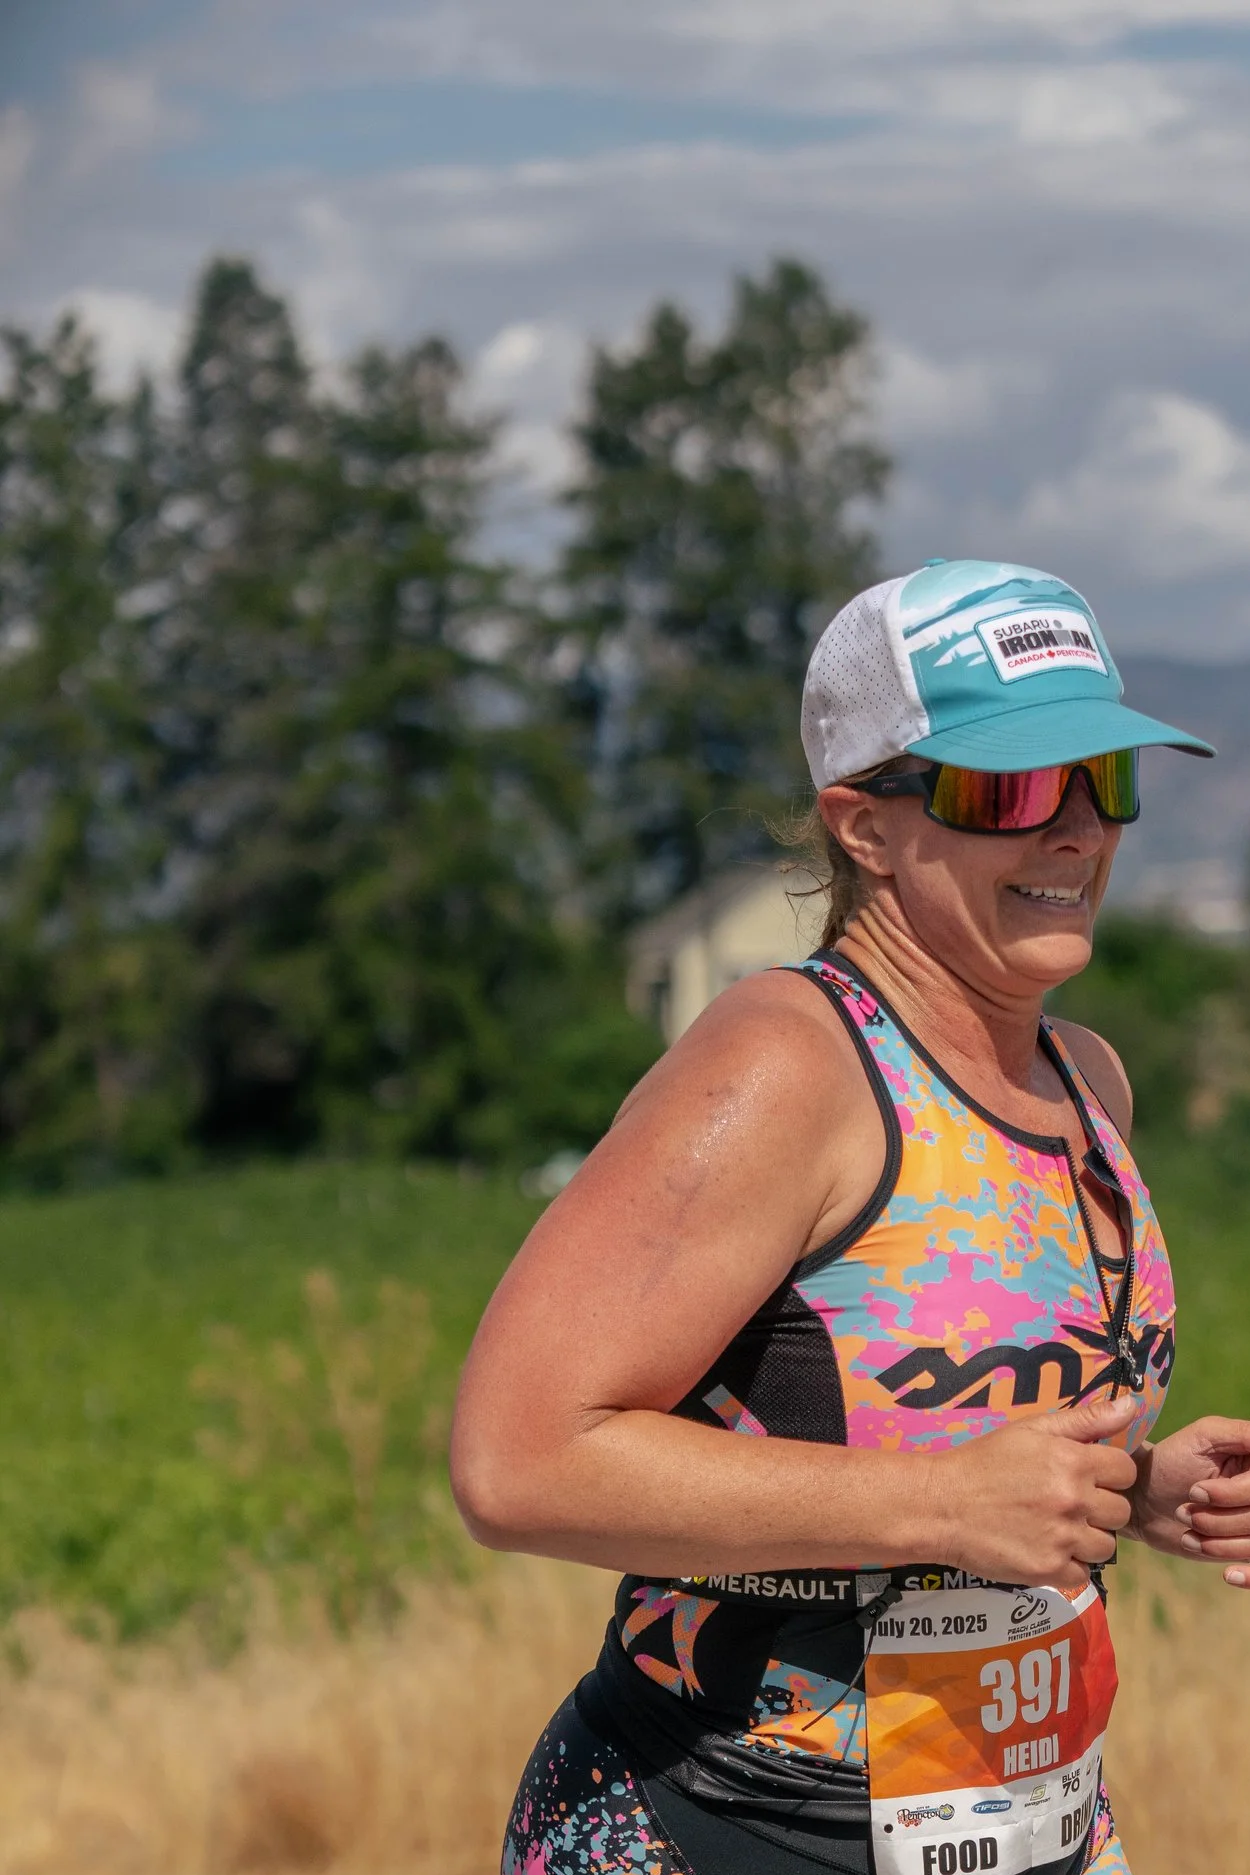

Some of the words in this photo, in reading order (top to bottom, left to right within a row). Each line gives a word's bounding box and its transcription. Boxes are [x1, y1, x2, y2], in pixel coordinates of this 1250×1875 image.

[993, 619, 1050, 640] SUBARU
[1008, 653, 1046, 668] CANADA
[1056, 650, 1091, 658] PENTICTON
[909, 1617, 938, 1638] 20,
[942, 1614, 988, 1635] 2025
[1007, 1625, 1029, 1635] PEACH
[980, 1638, 1070, 1733] 397
[1004, 1733, 1059, 1777] HEIDI
[1062, 1768, 1081, 1784] BLUE
[1062, 1777, 1080, 1797] 70
[974, 1801, 1010, 1812] TIFOSI
